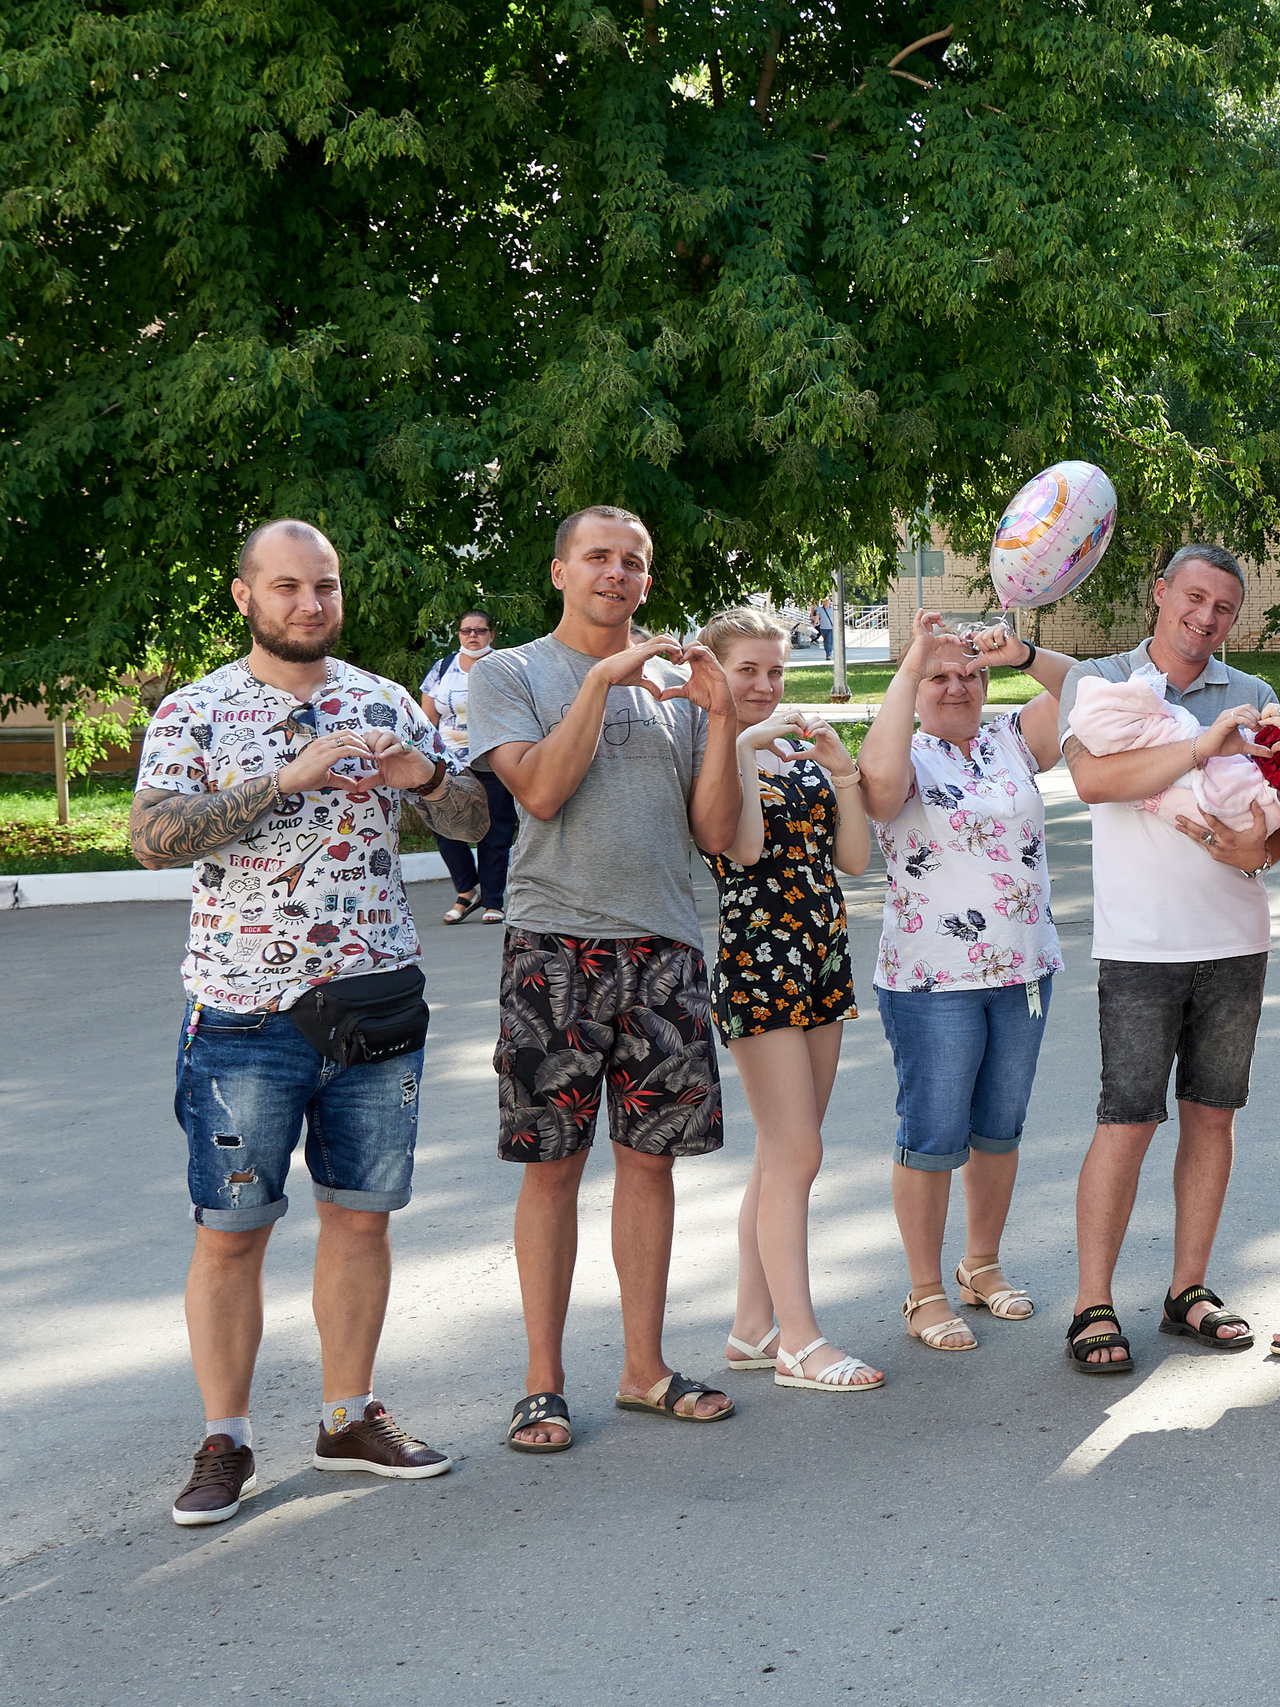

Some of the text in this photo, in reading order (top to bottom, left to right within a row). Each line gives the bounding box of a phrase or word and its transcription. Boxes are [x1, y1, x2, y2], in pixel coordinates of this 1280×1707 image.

[212, 709, 276, 723] ROCK!
[325, 716, 362, 733] YES!
[268, 817, 303, 831] LOUD
[229, 854, 286, 873] ROCK!
[330, 865, 366, 883] YES!
[191, 912, 222, 930] OVE
[356, 909, 392, 925] LOVE
[255, 966, 291, 975] LOUD
[204, 985, 261, 1006] ROCK!
